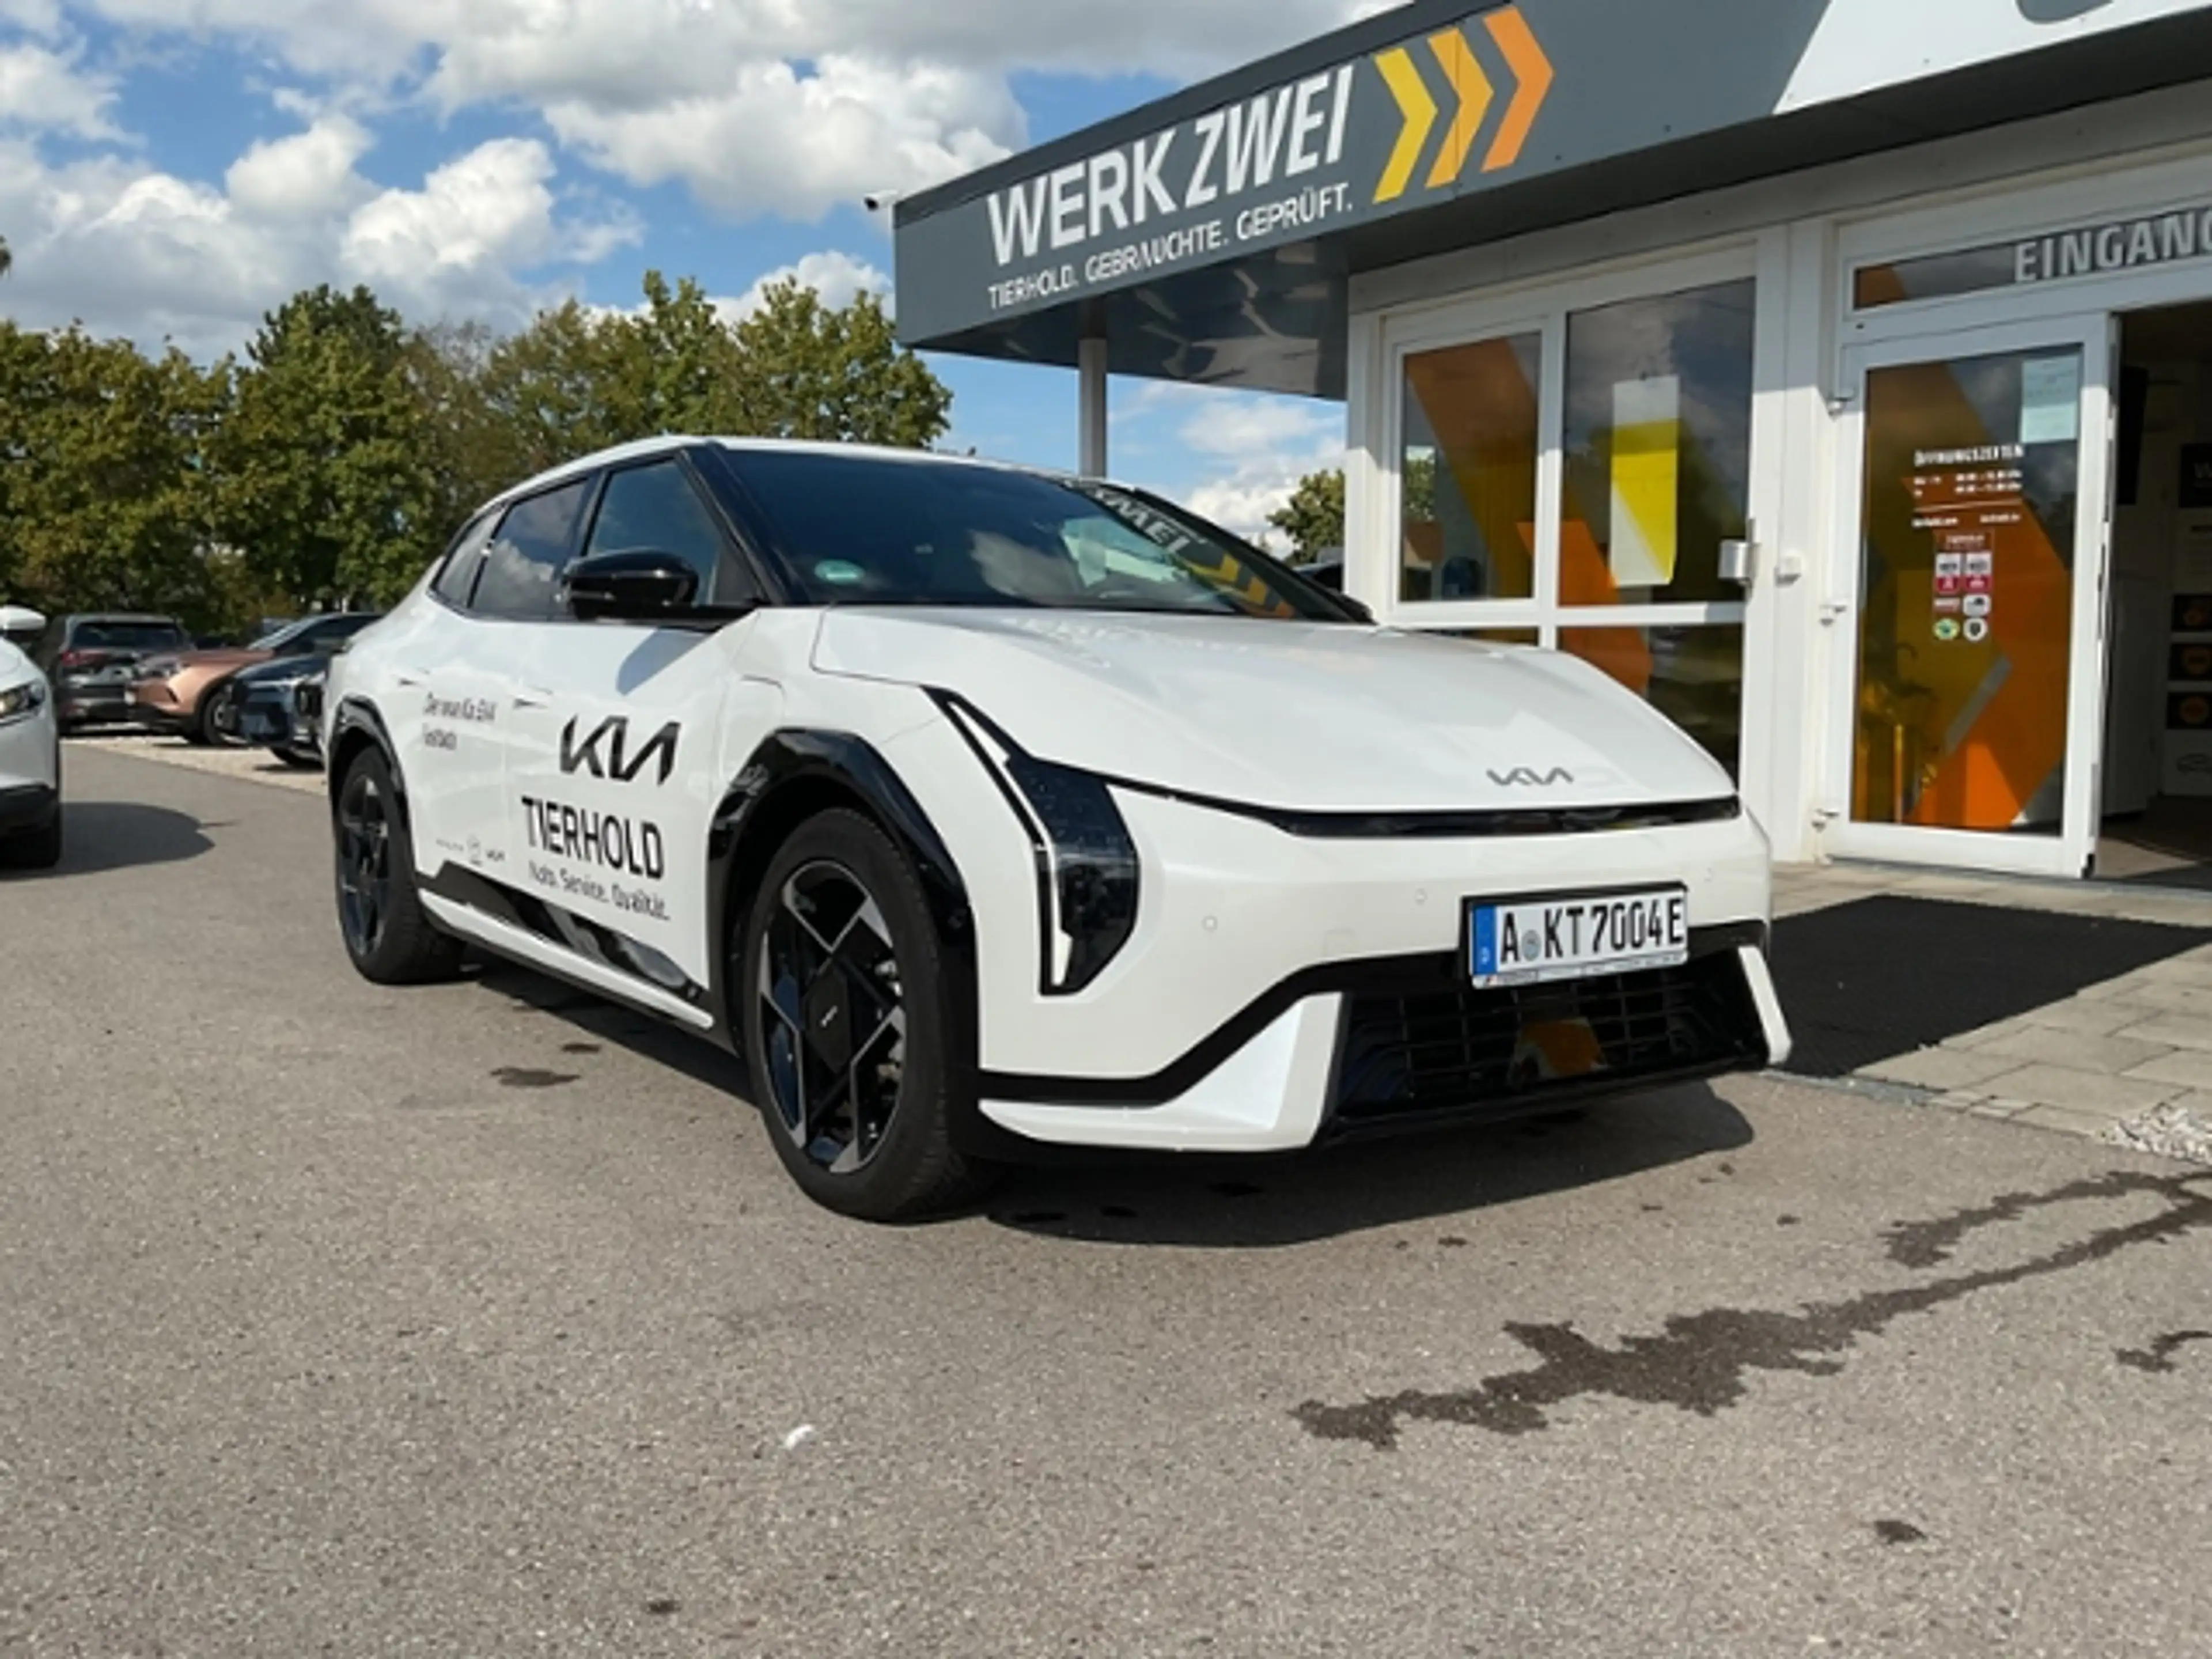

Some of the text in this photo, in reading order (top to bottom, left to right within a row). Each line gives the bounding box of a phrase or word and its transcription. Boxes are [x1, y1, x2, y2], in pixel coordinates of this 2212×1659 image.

[987, 64, 1353, 267] WERK ZWEI
[988, 181, 1353, 309] TIERHOLD. GEBRAUCHTE. GEPRÜFT.
[521, 795, 664, 880] TIERHOLD
